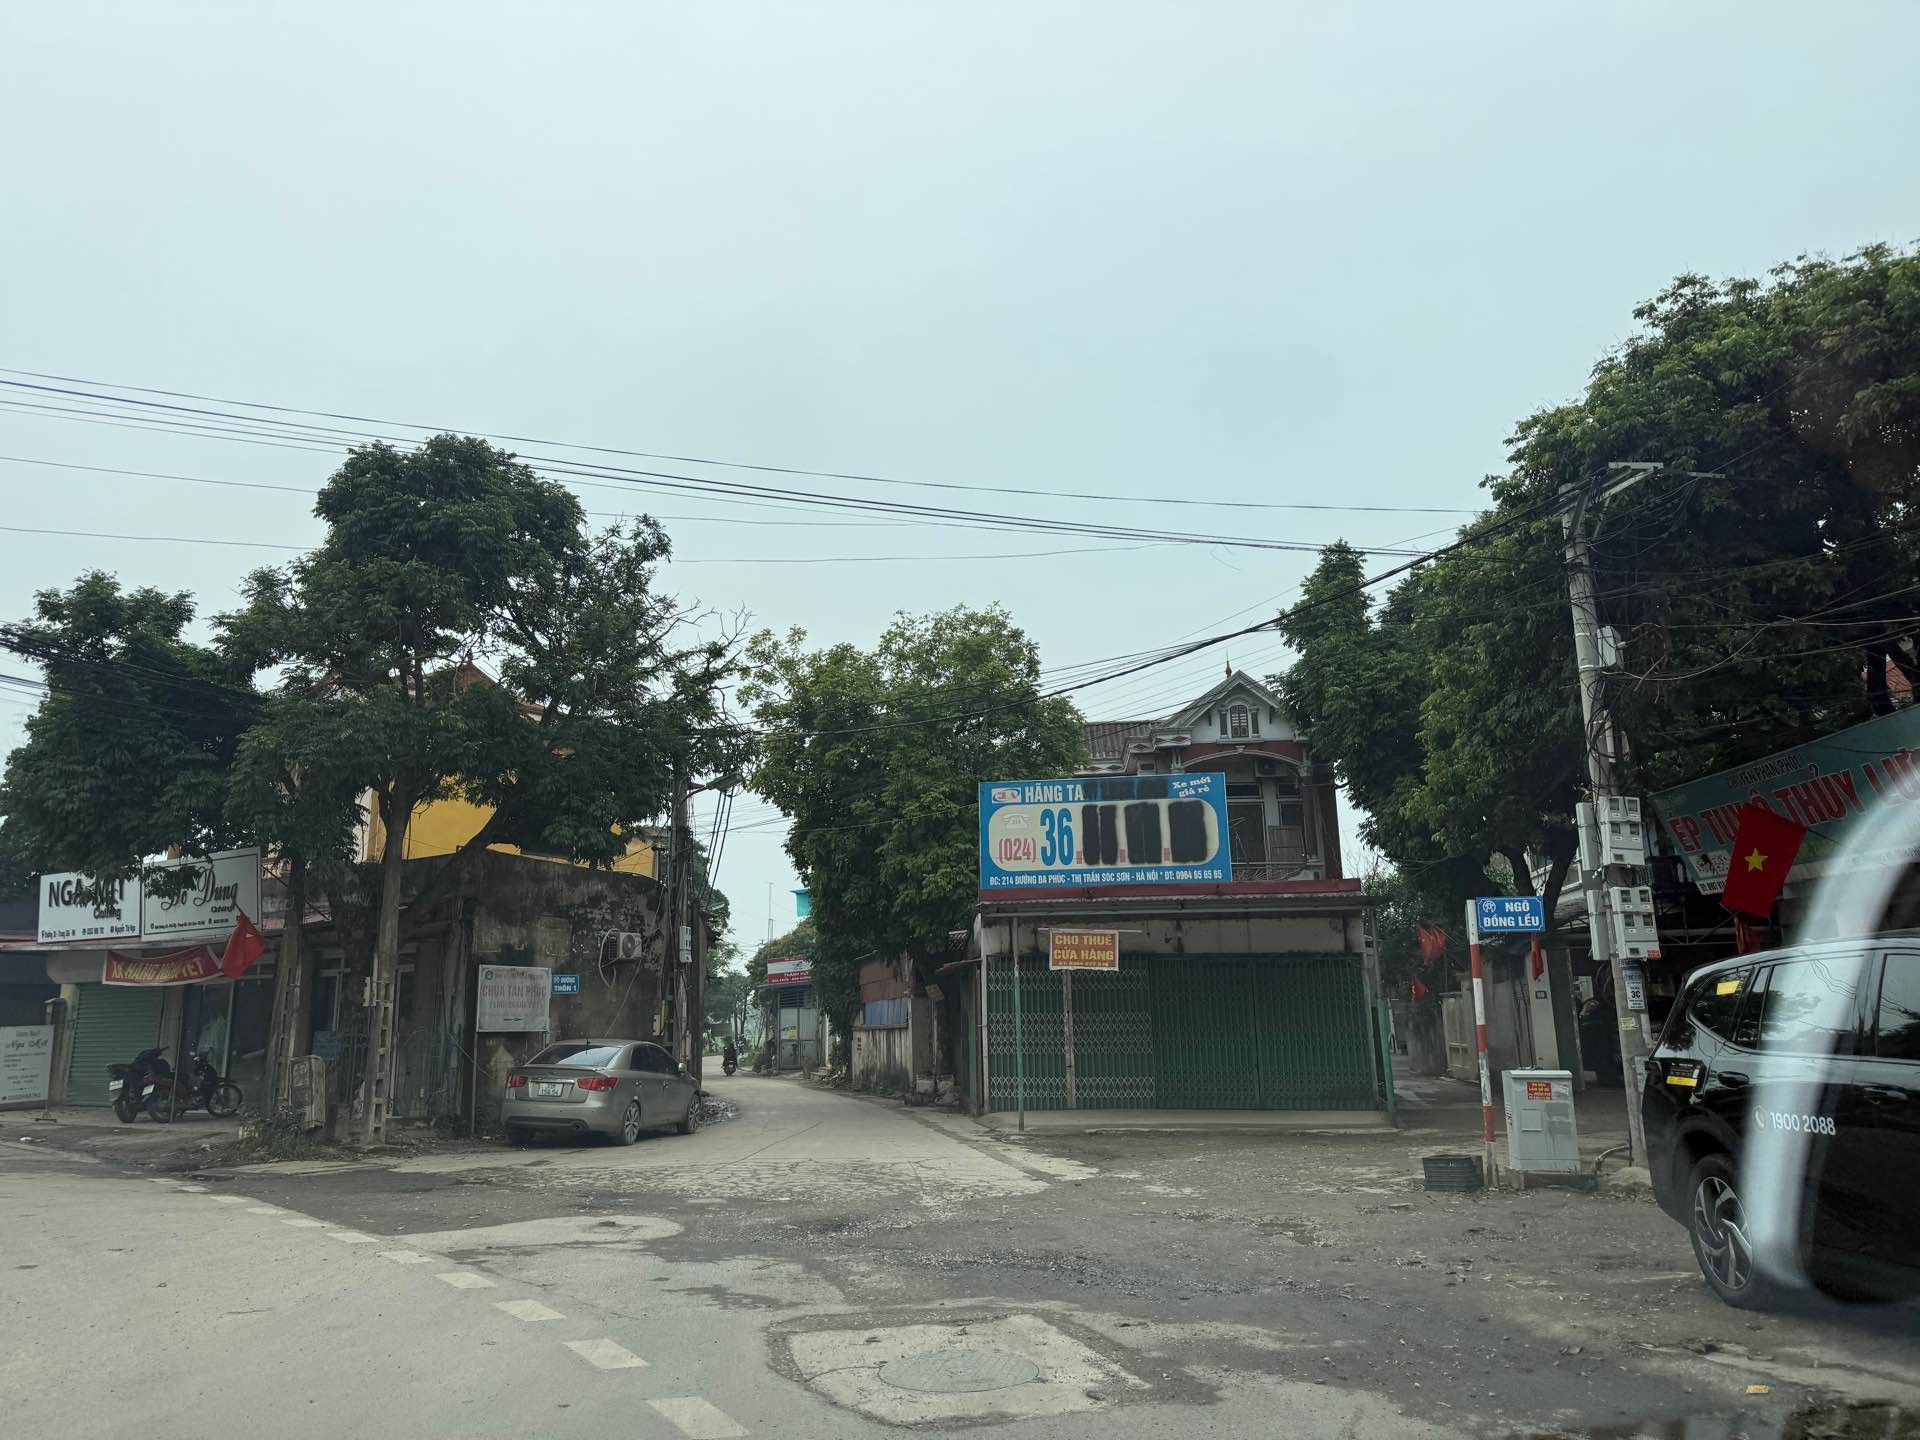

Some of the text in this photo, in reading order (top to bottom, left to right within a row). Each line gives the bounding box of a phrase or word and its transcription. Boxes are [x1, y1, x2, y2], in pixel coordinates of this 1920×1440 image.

[1172, 781, 1187, 789] Xe
[1024, 783, 1063, 803] HÃNG
[998, 838, 1037, 864] (024)
[1002, 876, 1014, 885] 214
[1135, 869, 1145, 880] HÀ
[1146, 869, 1158, 882] NỘI
[1505, 900, 1530, 912] NGÕ
[1055, 934, 1112, 945] CHO THUÊ
[1053, 946, 1114, 960] CỬA HÀNG
[1771, 1112, 1836, 1136] 1900 2088
